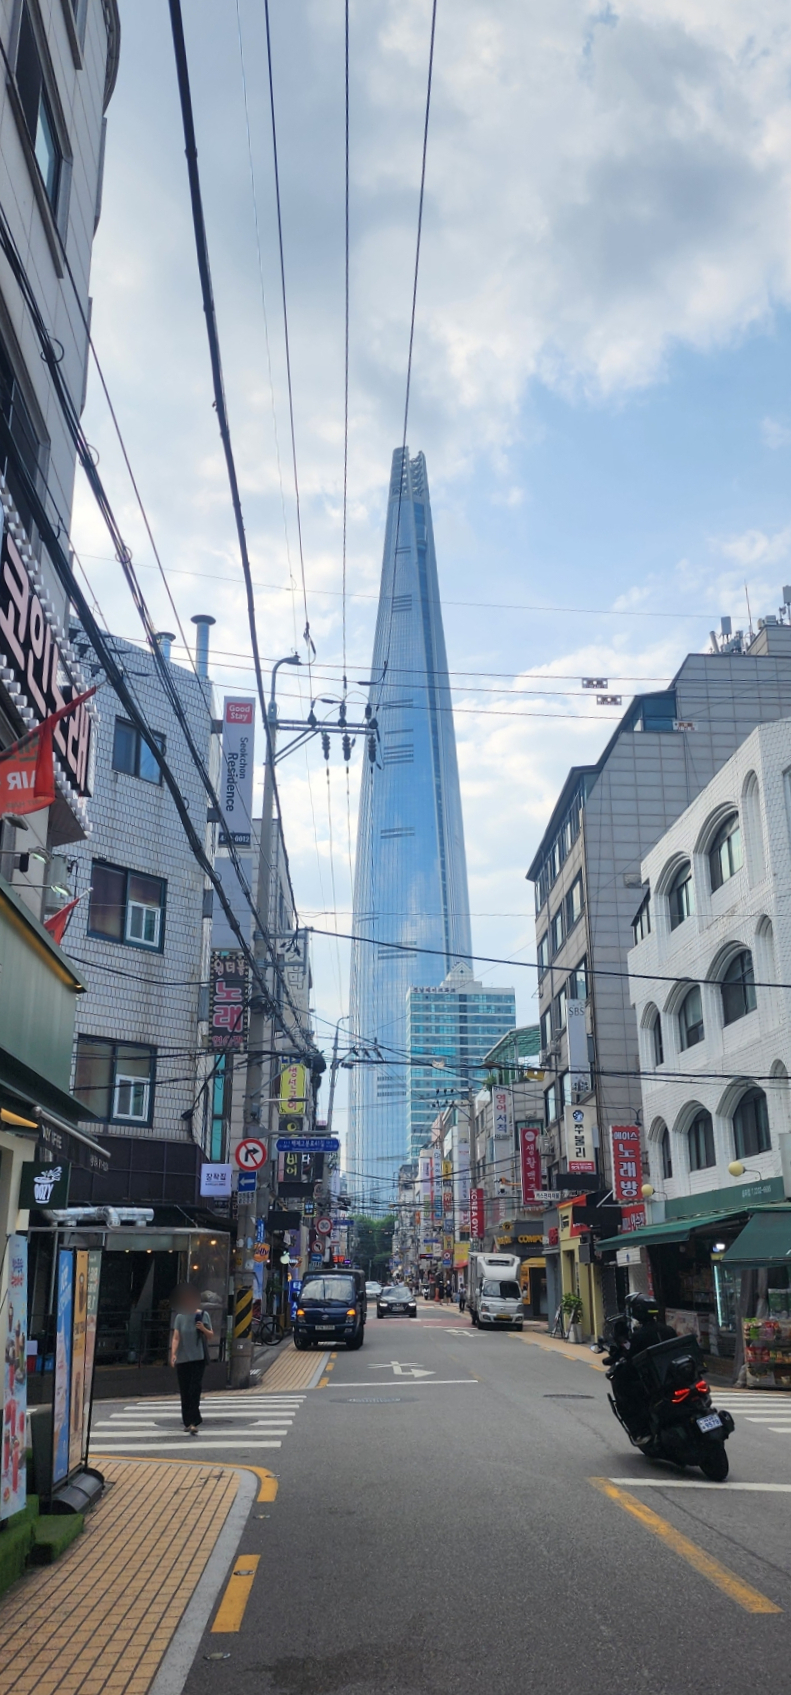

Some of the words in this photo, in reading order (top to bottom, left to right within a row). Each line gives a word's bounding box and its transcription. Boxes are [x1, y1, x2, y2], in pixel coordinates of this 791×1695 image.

[229, 704, 251, 713] Good
[230, 712, 248, 721] Stay
[239, 737, 249, 779] Seokchon
[226, 752, 239, 812] Residence
[212, 978, 244, 1033] 노래
[568, 1006, 585, 1016] SBS
[613, 1131, 638, 1140] 에이스
[618, 1143, 638, 1197] 노래방
